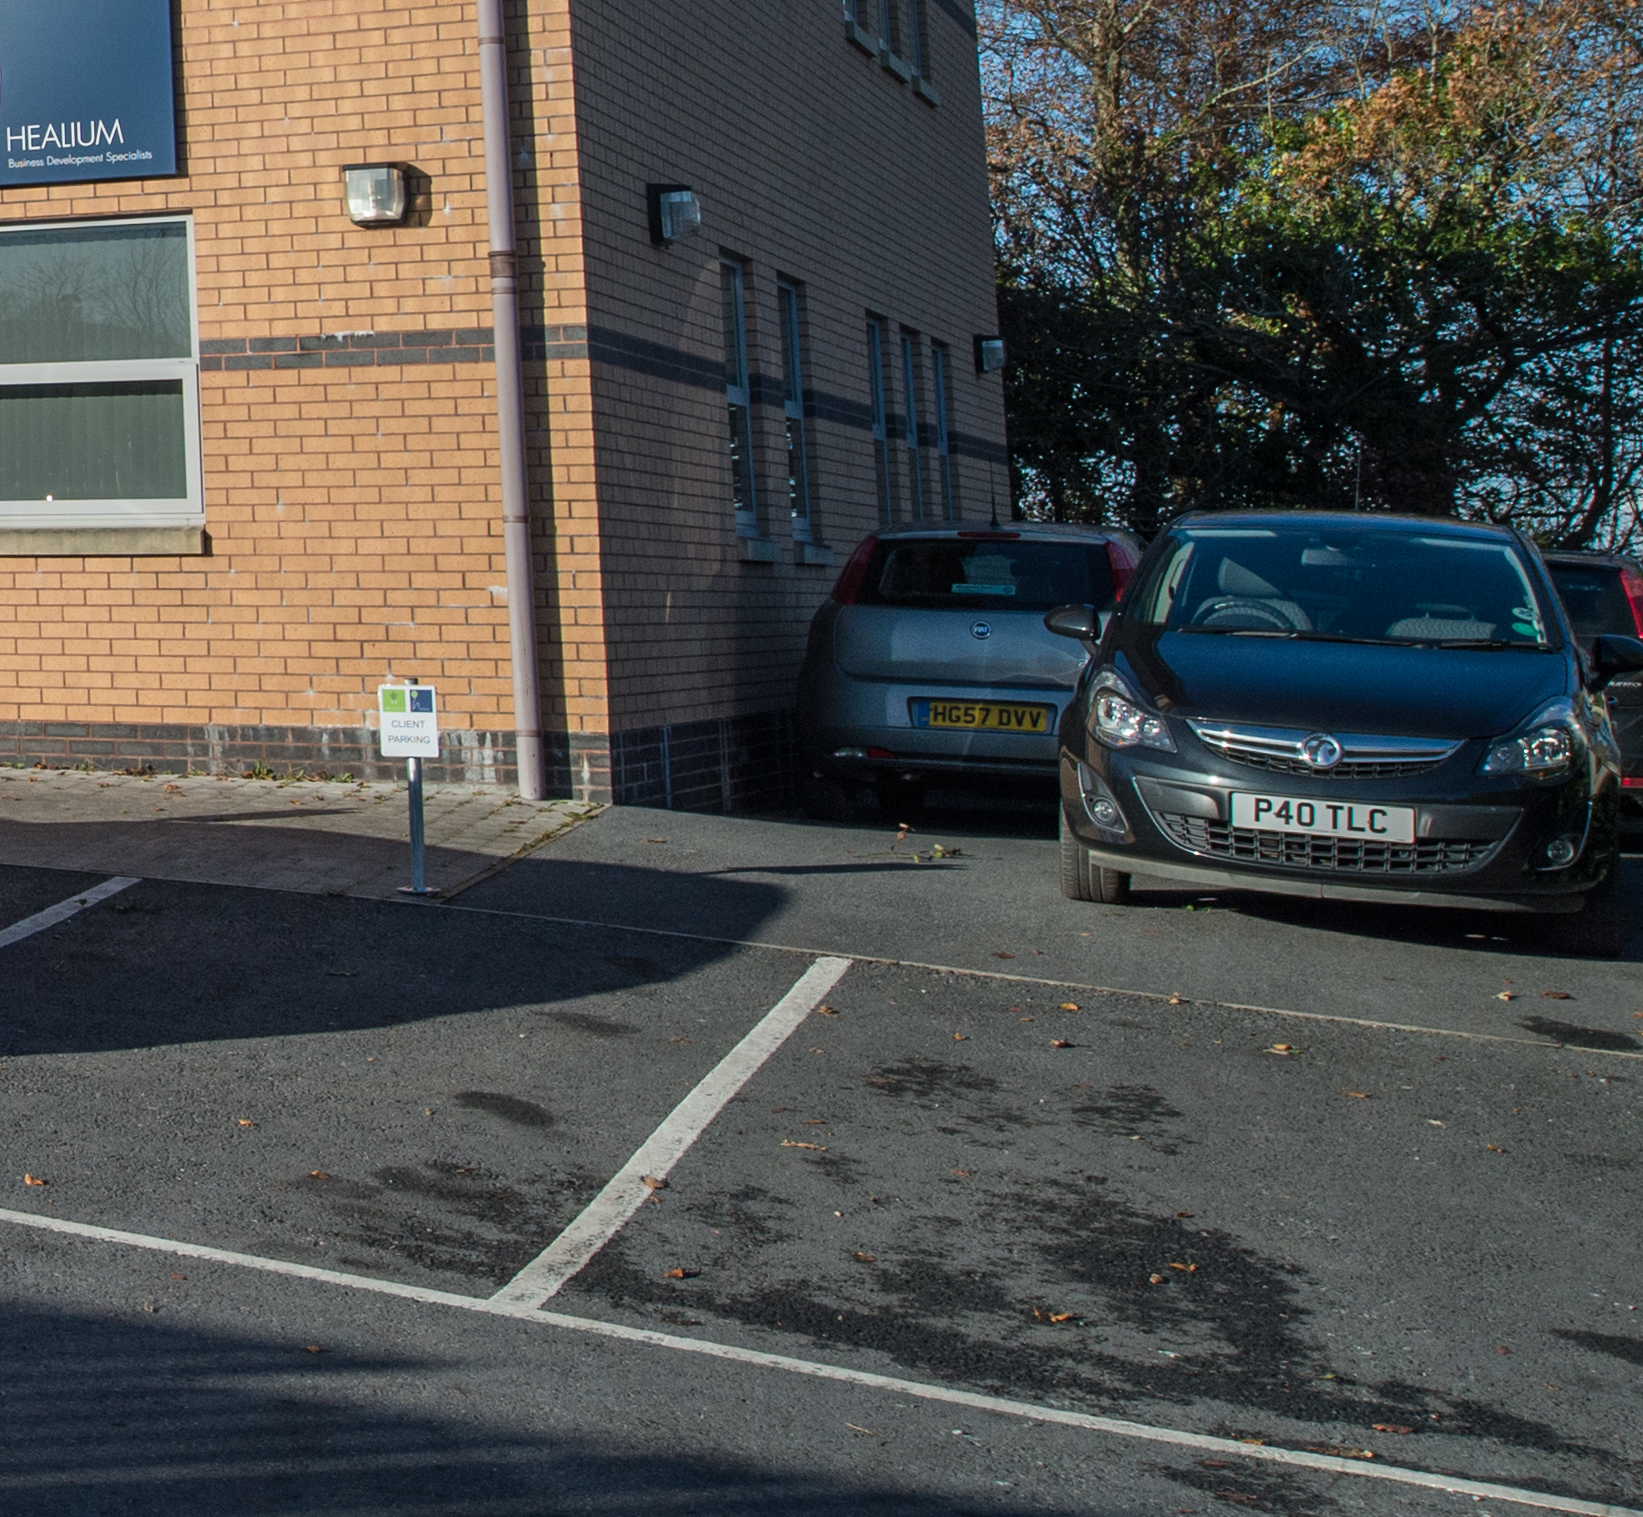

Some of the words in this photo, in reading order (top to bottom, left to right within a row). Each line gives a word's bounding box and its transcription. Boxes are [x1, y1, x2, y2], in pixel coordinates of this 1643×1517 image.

[6, 118, 125, 152] HEALIUM
[8, 158, 45, 169] Business
[46, 153, 104, 167] Development
[105, 149, 153, 165] Specialists
[390, 719, 426, 729] CLIENT
[932, 705, 992, 725] HG57
[997, 708, 1042, 729] DVV
[387, 735, 431, 745] PARKING
[1254, 797, 1315, 827] P40
[1325, 803, 1388, 834] TLC
